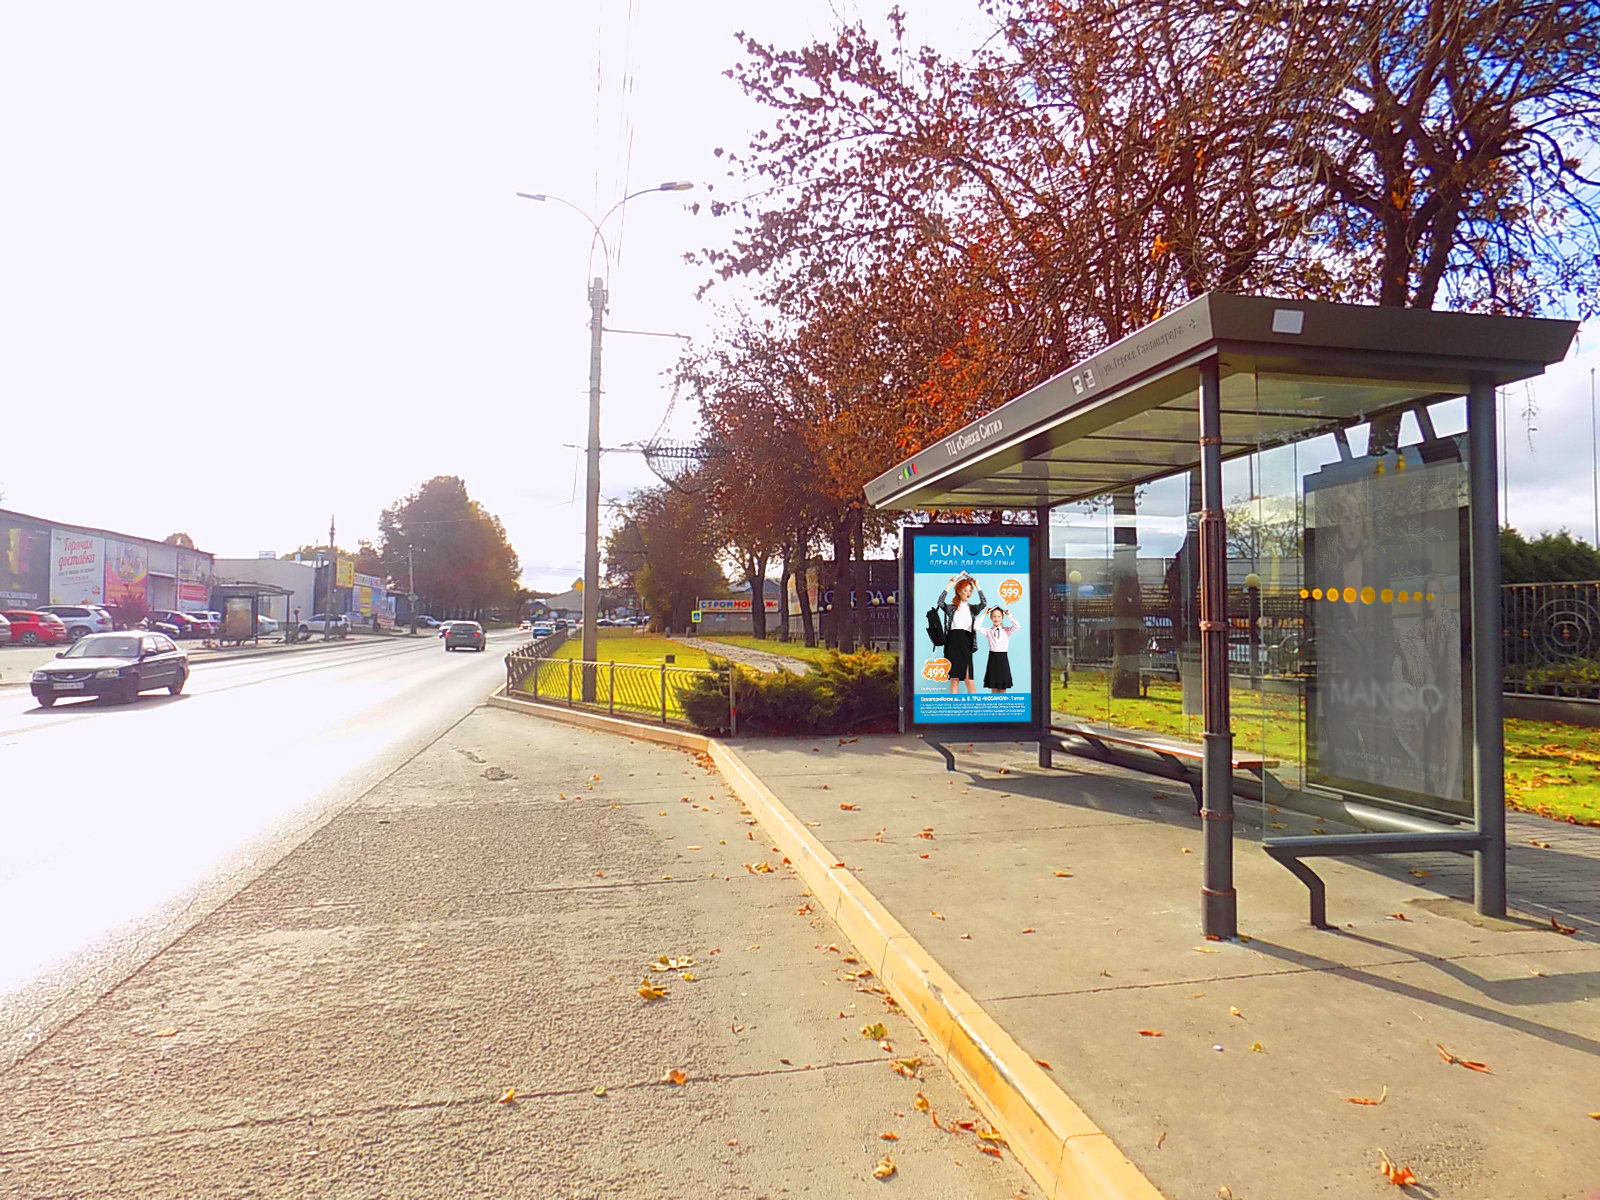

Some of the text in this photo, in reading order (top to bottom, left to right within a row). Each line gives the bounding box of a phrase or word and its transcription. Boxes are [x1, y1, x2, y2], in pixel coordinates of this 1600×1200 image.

[944, 439, 958, 457] ТЦ
[929, 544, 1016, 557] FUN DAY
[929, 559, 958, 567] ОДЕЖДА
[1330, 679, 1444, 714] MANGO
